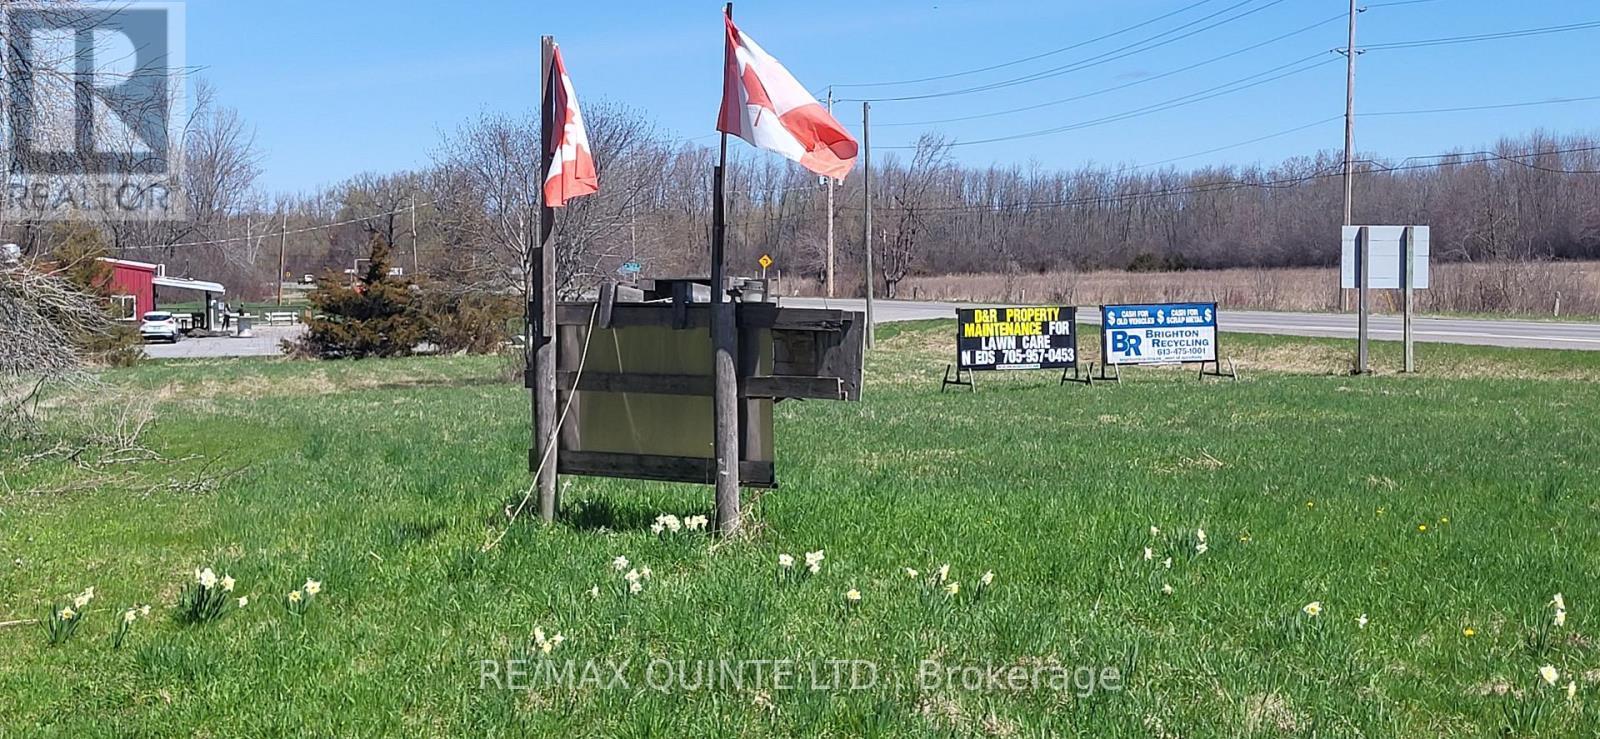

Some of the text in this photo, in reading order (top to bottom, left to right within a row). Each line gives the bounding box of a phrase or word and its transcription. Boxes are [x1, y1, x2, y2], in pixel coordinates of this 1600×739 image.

[974, 307, 1060, 323] D&R PROPERTY
[1121, 310, 1149, 318] CASH FOR
[1170, 308, 1199, 317] CASH FOR
[1116, 317, 1155, 326] OLD VEHICLES
[1166, 315, 1204, 324] SCRAP METAL
[964, 321, 1070, 337] MAINTENANCE FOR
[1145, 329, 1199, 338] BRIGHTON
[981, 335, 1051, 350] LAWN CARE
[1111, 330, 1142, 356] BR
[1152, 338, 1209, 348] RECYCLING
[1002, 348, 1075, 363] 705-957-0453
[1157, 347, 1206, 356] 613-475-1001
